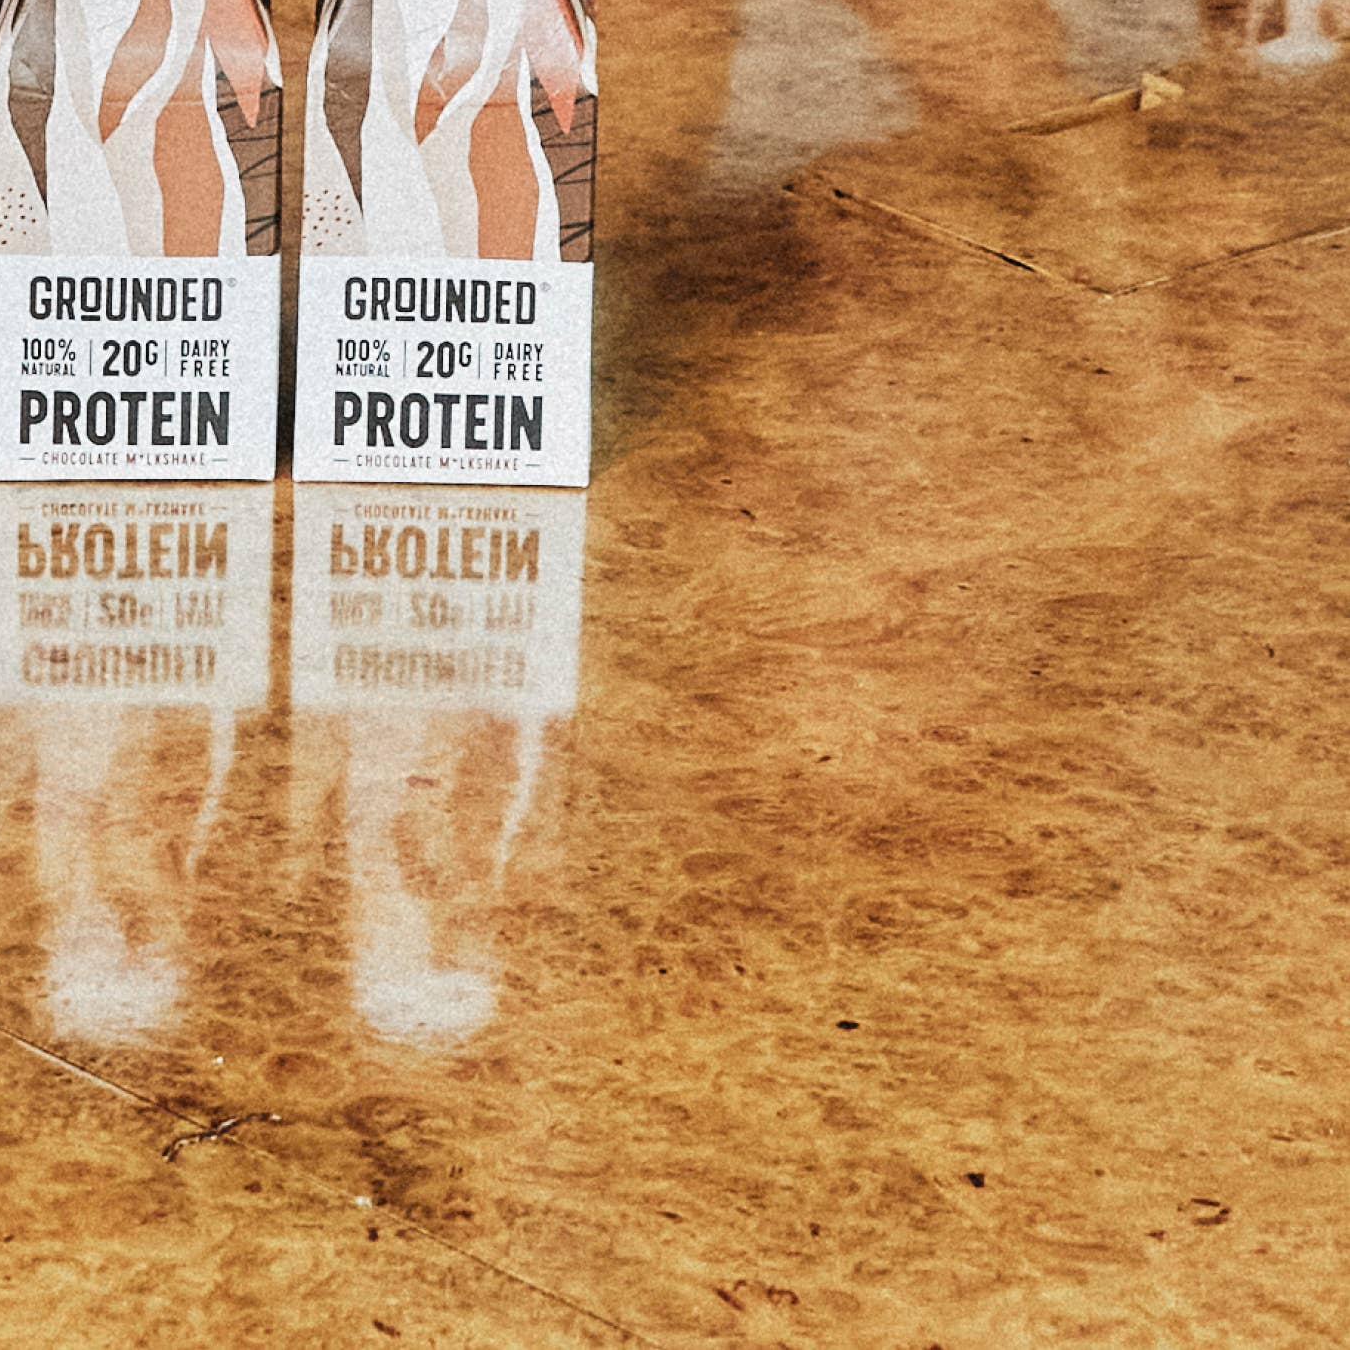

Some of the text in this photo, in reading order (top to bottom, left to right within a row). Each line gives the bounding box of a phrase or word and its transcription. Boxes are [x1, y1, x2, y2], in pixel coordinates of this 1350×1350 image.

[29, 275, 223, 322] GROUNDED
[344, 276, 536, 325] GROUNDED
[22, 337, 76, 362] 100%
[102, 339, 159, 377] 20G
[180, 339, 230, 358] DAIRY
[336, 338, 391, 362] 100%
[416, 340, 472, 379] 20G
[494, 342, 544, 361] DAIRY
[21, 361, 76, 377] NATURAL
[180, 358, 230, 378] FREE
[335, 362, 390, 378] NATURAL
[493, 361, 543, 382] FREE
[19, 389, 230, 446] PROTEIN
[333, 390, 543, 452] PROTEIN
[42, 451, 118, 466] CHOCOLATE
[356, 453, 431, 469] CHOCOLATE
